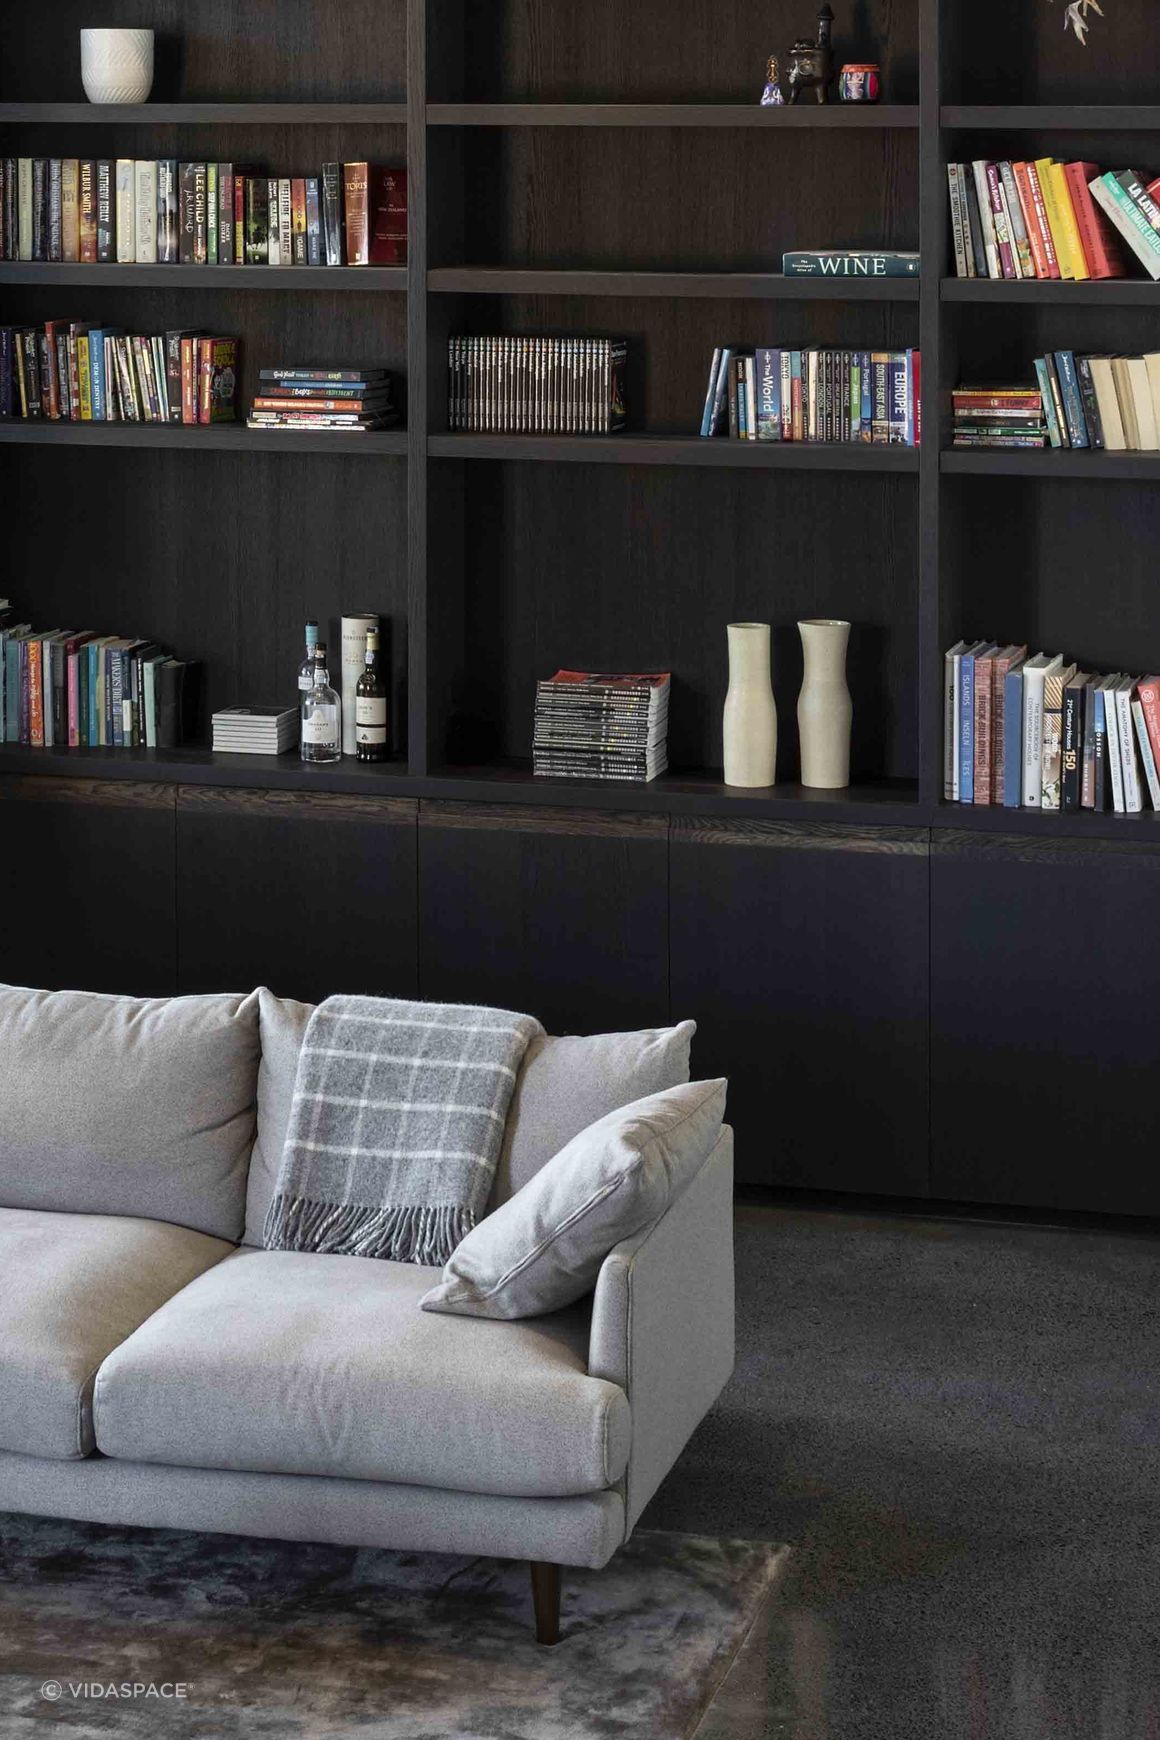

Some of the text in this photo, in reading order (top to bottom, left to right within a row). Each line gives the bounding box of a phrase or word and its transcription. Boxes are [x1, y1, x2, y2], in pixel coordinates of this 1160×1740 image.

[82, 164, 91, 213] WILBUR SMITH
[100, 165, 110, 222] MATTHEW REILLY
[196, 174, 204, 192] LEE
[1128, 183, 1142, 197] LA
[196, 193, 204, 223] CHILD
[952, 195, 960, 227] SMOOTHIE
[955, 228, 963, 254] KITCHEN
[818, 257, 887, 275] WINE
[763, 376, 774, 412] World
[876, 364, 885, 419] SOUTH-EAST ASIA
[894, 371, 906, 414] EUROPE
[963, 675, 971, 706] ISLANDS
[1065, 708, 1073, 730] Century
[1065, 750, 1077, 770] 150
